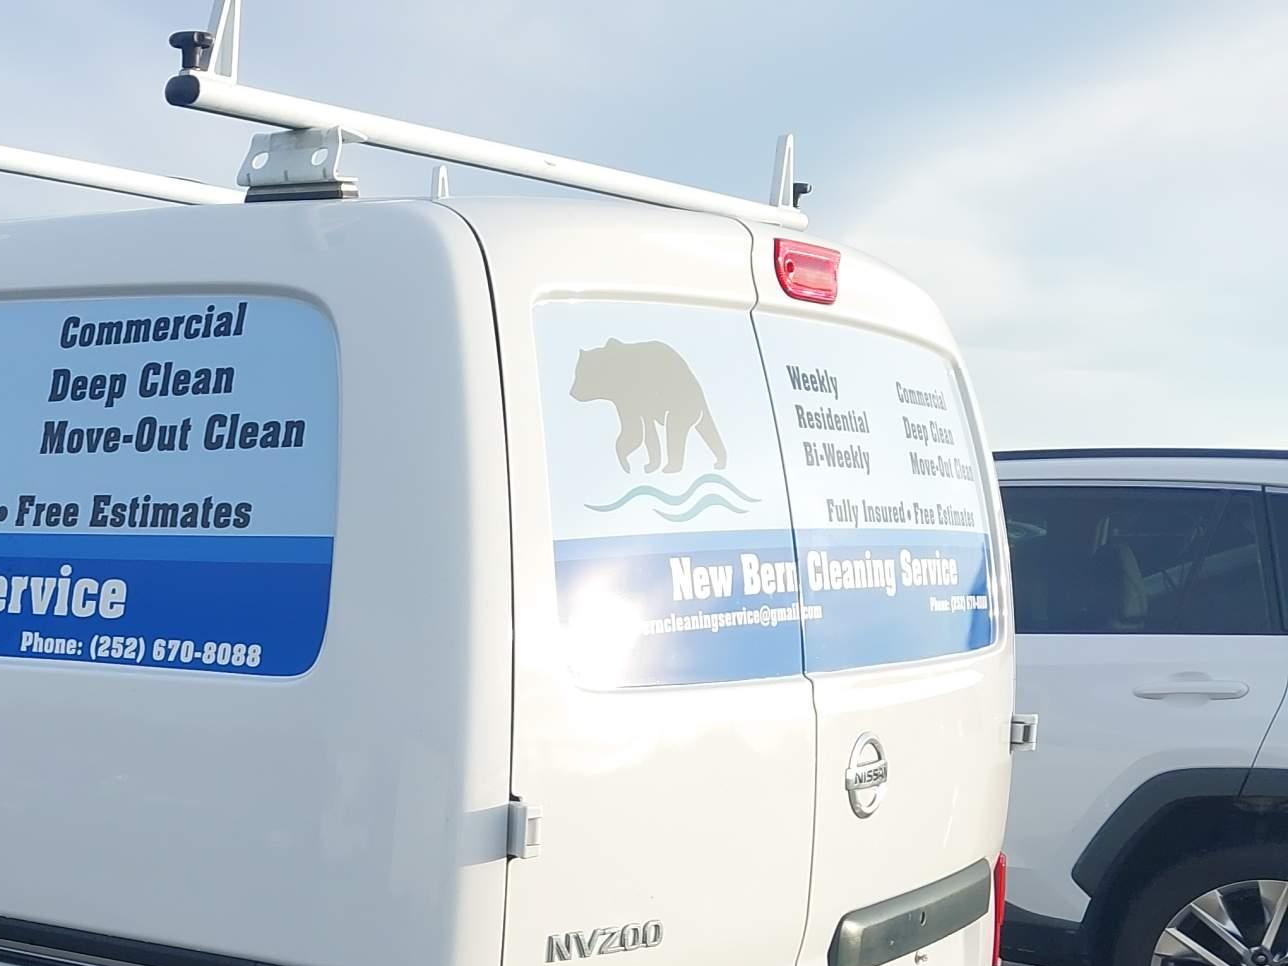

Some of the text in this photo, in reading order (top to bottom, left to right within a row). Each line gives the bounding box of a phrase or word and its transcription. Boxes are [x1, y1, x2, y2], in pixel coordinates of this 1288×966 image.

[59, 302, 248, 349] Commercial
[48, 361, 236, 407] Deep Clean
[786, 364, 839, 400] Weekly
[896, 381, 947, 411] Commercial
[39, 413, 306, 455] Move-Out Clean
[794, 404, 870, 434] Residential
[902, 415, 955, 446] Deep Clean
[803, 441, 870, 475] Bi-Weekly
[909, 451, 954, 479] Move-Out
[15, 495, 79, 527] Free
[89, 493, 253, 529] Estimates
[826, 498, 975, 528] Fully Insured Free Estimates
[669, 549, 959, 601] New Bern Cleaning Service
[20, 631, 262, 668] Phone: (252) 670-8088
[545, 920, 664, 963] NV200
